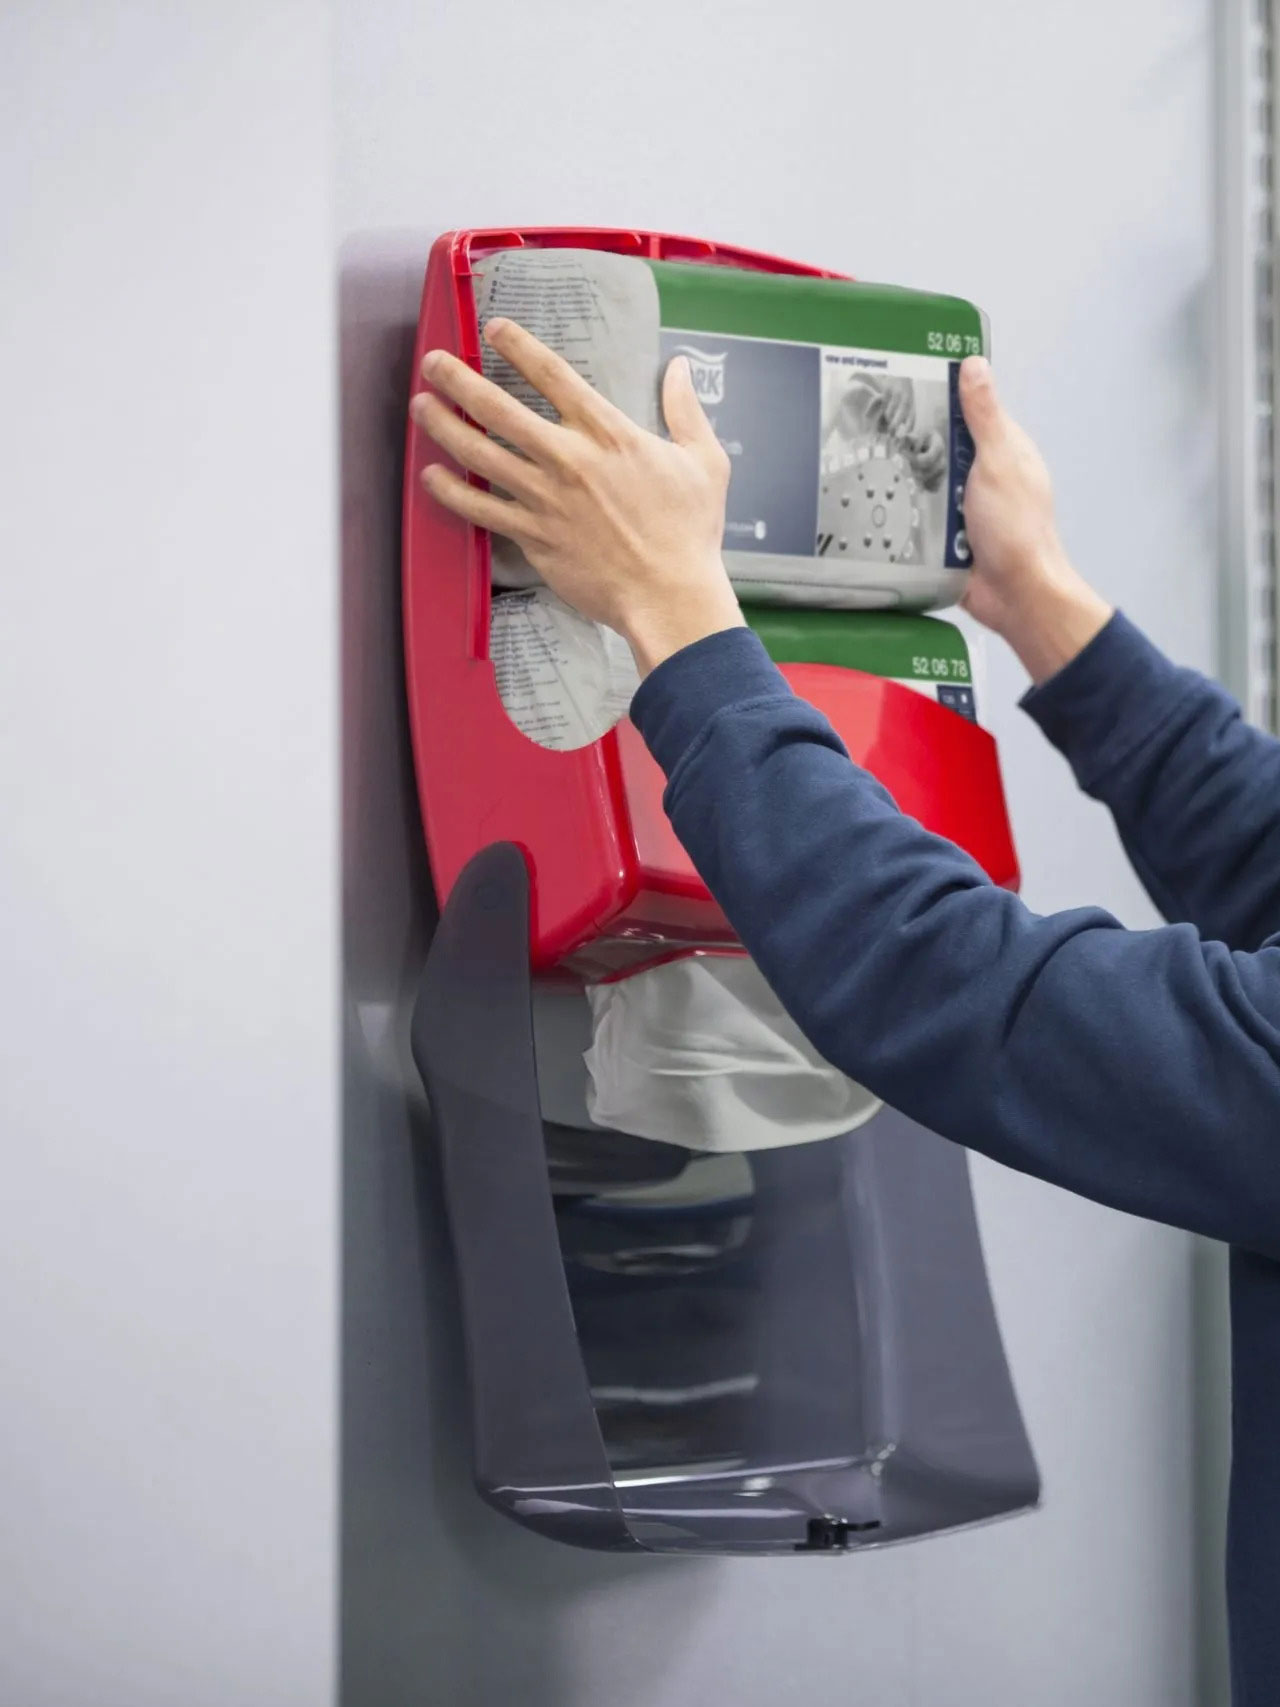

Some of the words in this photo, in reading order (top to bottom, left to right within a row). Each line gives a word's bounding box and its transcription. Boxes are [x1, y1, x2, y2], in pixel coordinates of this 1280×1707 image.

[928, 331, 943, 351] 52
[945, 333, 961, 352] 06
[963, 335, 979, 354] 78
[912, 657, 929, 675] 52
[931, 658, 948, 676] 06
[951, 659, 968, 677] 78
